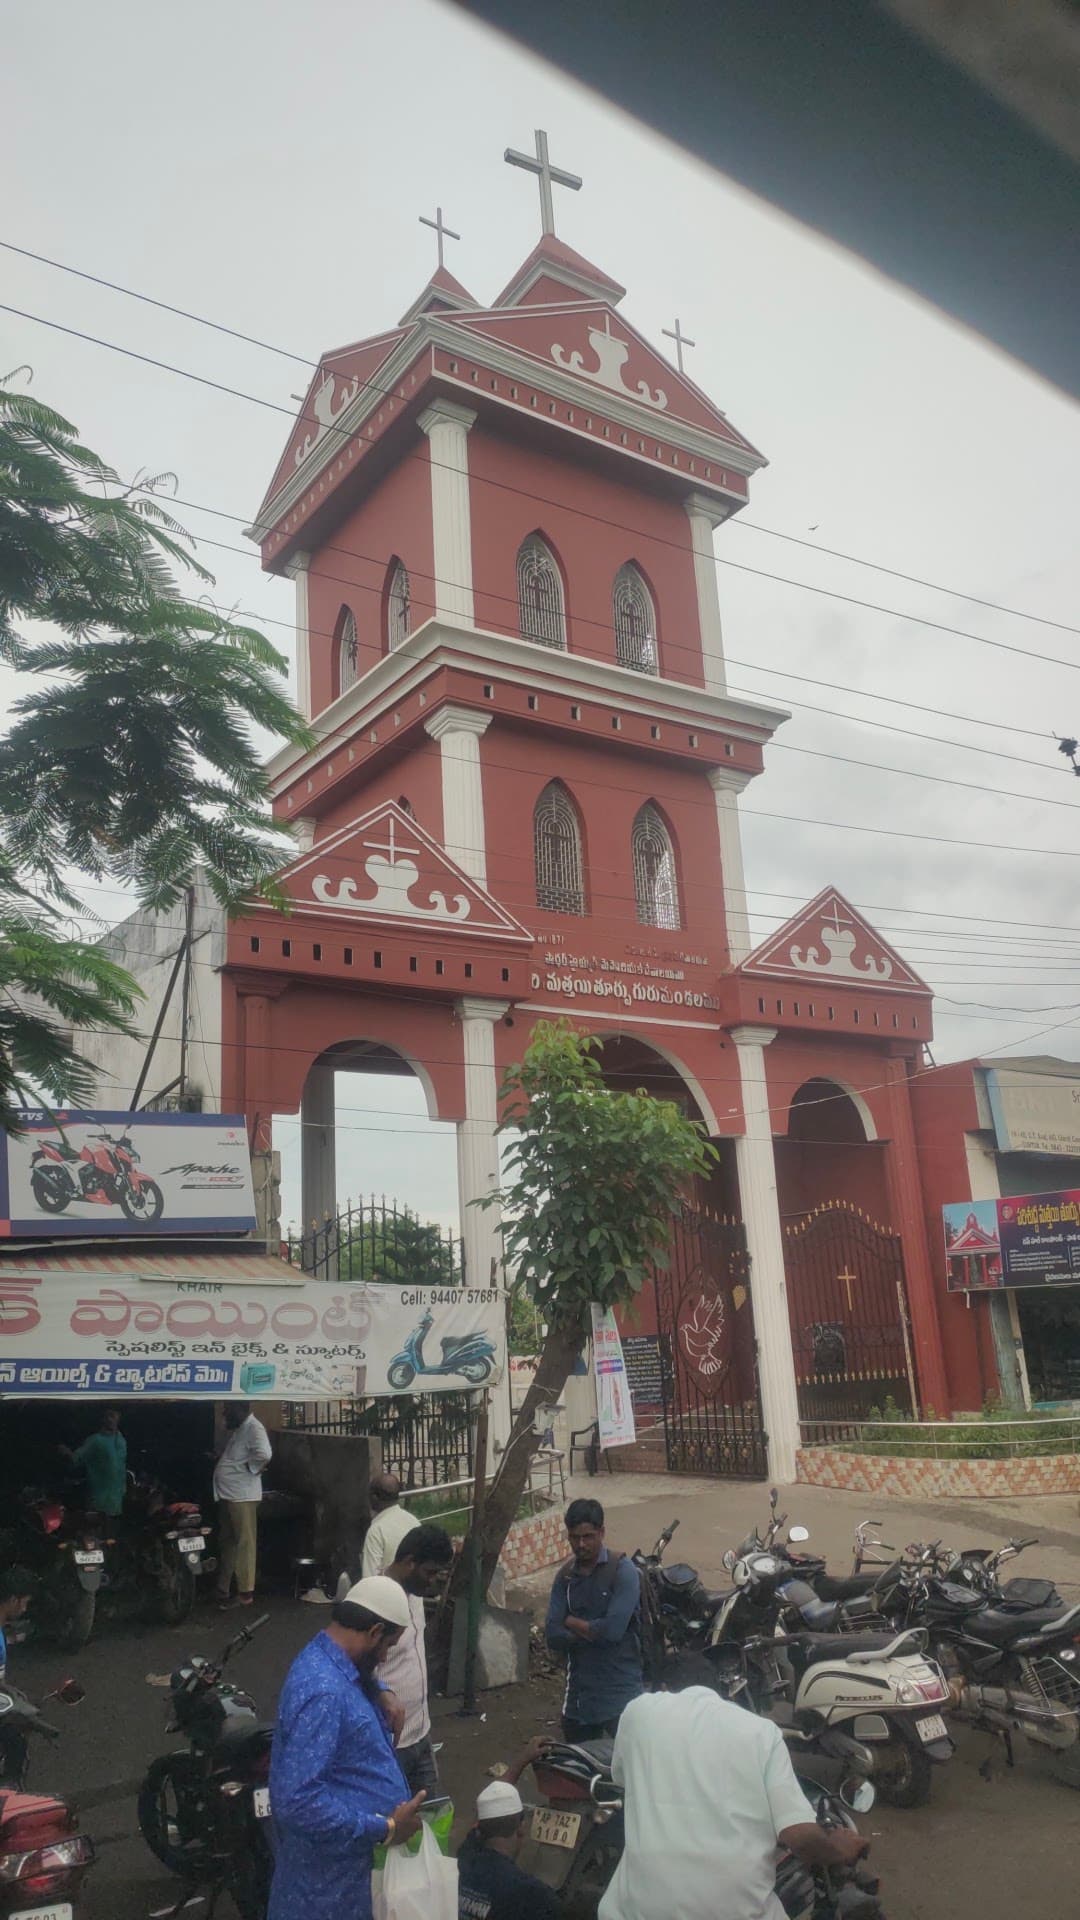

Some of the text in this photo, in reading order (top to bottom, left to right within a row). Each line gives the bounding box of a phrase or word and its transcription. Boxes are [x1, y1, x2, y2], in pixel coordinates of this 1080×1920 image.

[17, 1111, 45, 1121] TVS
[160, 1163, 241, 1177] Apache
[400, 1287, 499, 1306] Cell: 94407 57681
[70, 1288, 386, 1343] పాయింట్
[191, 1340, 226, 1354] ఇన్
[272, 1343, 289, 1355] &
[94, 1364, 111, 1383] &
